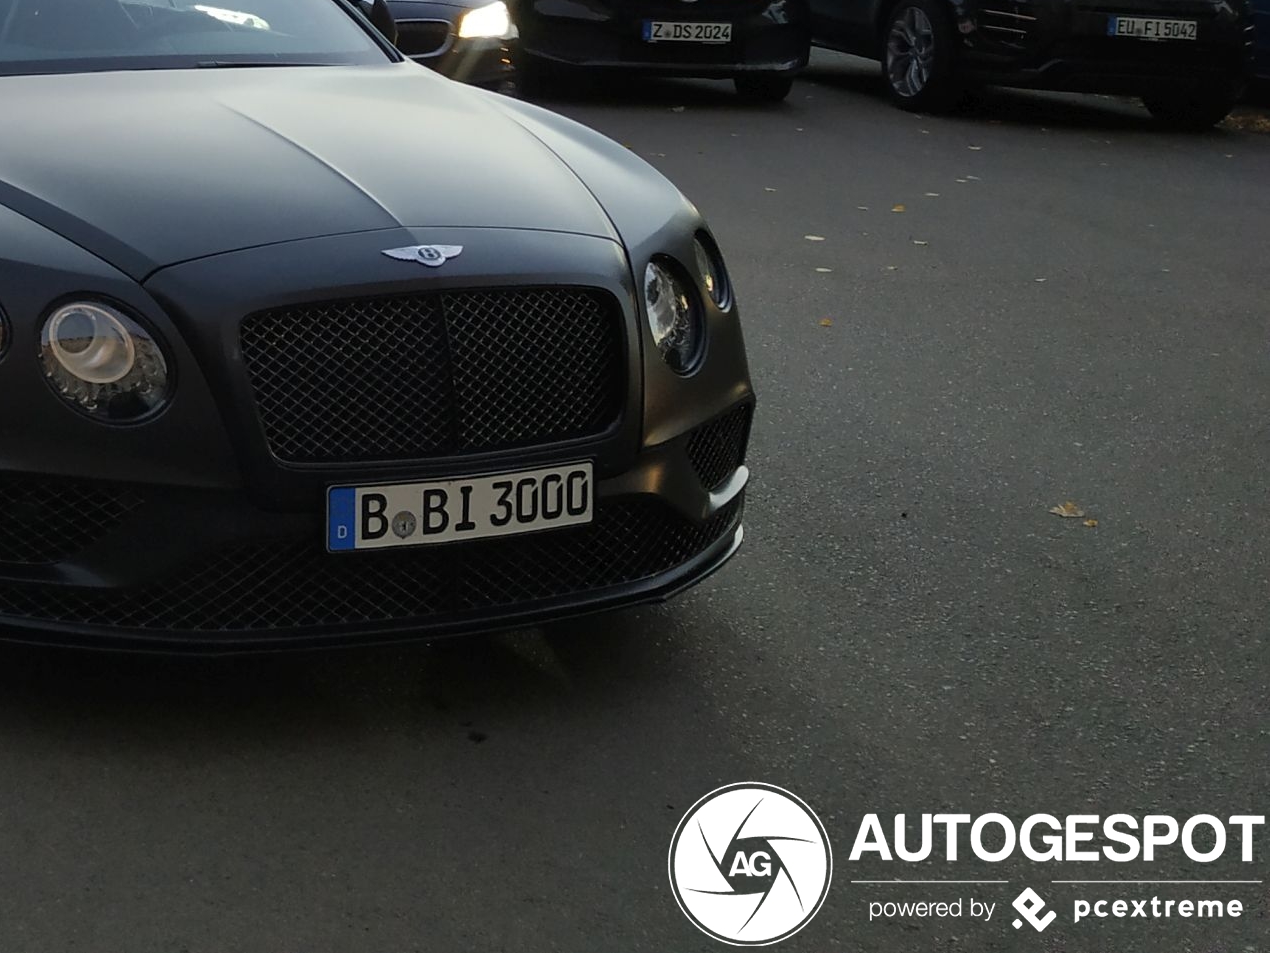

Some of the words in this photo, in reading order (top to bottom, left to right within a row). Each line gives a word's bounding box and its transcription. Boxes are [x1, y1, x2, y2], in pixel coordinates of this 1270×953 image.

[652, 23, 663, 38] Z
[673, 24, 691, 39] DS
[694, 25, 730, 40] 2024
[1117, 19, 1135, 35] EU
[1144, 21, 1161, 36] FI
[1164, 22, 1196, 38] 5042
[361, 493, 389, 540] B
[422, 486, 476, 535] BI
[489, 470, 588, 526] 3000
